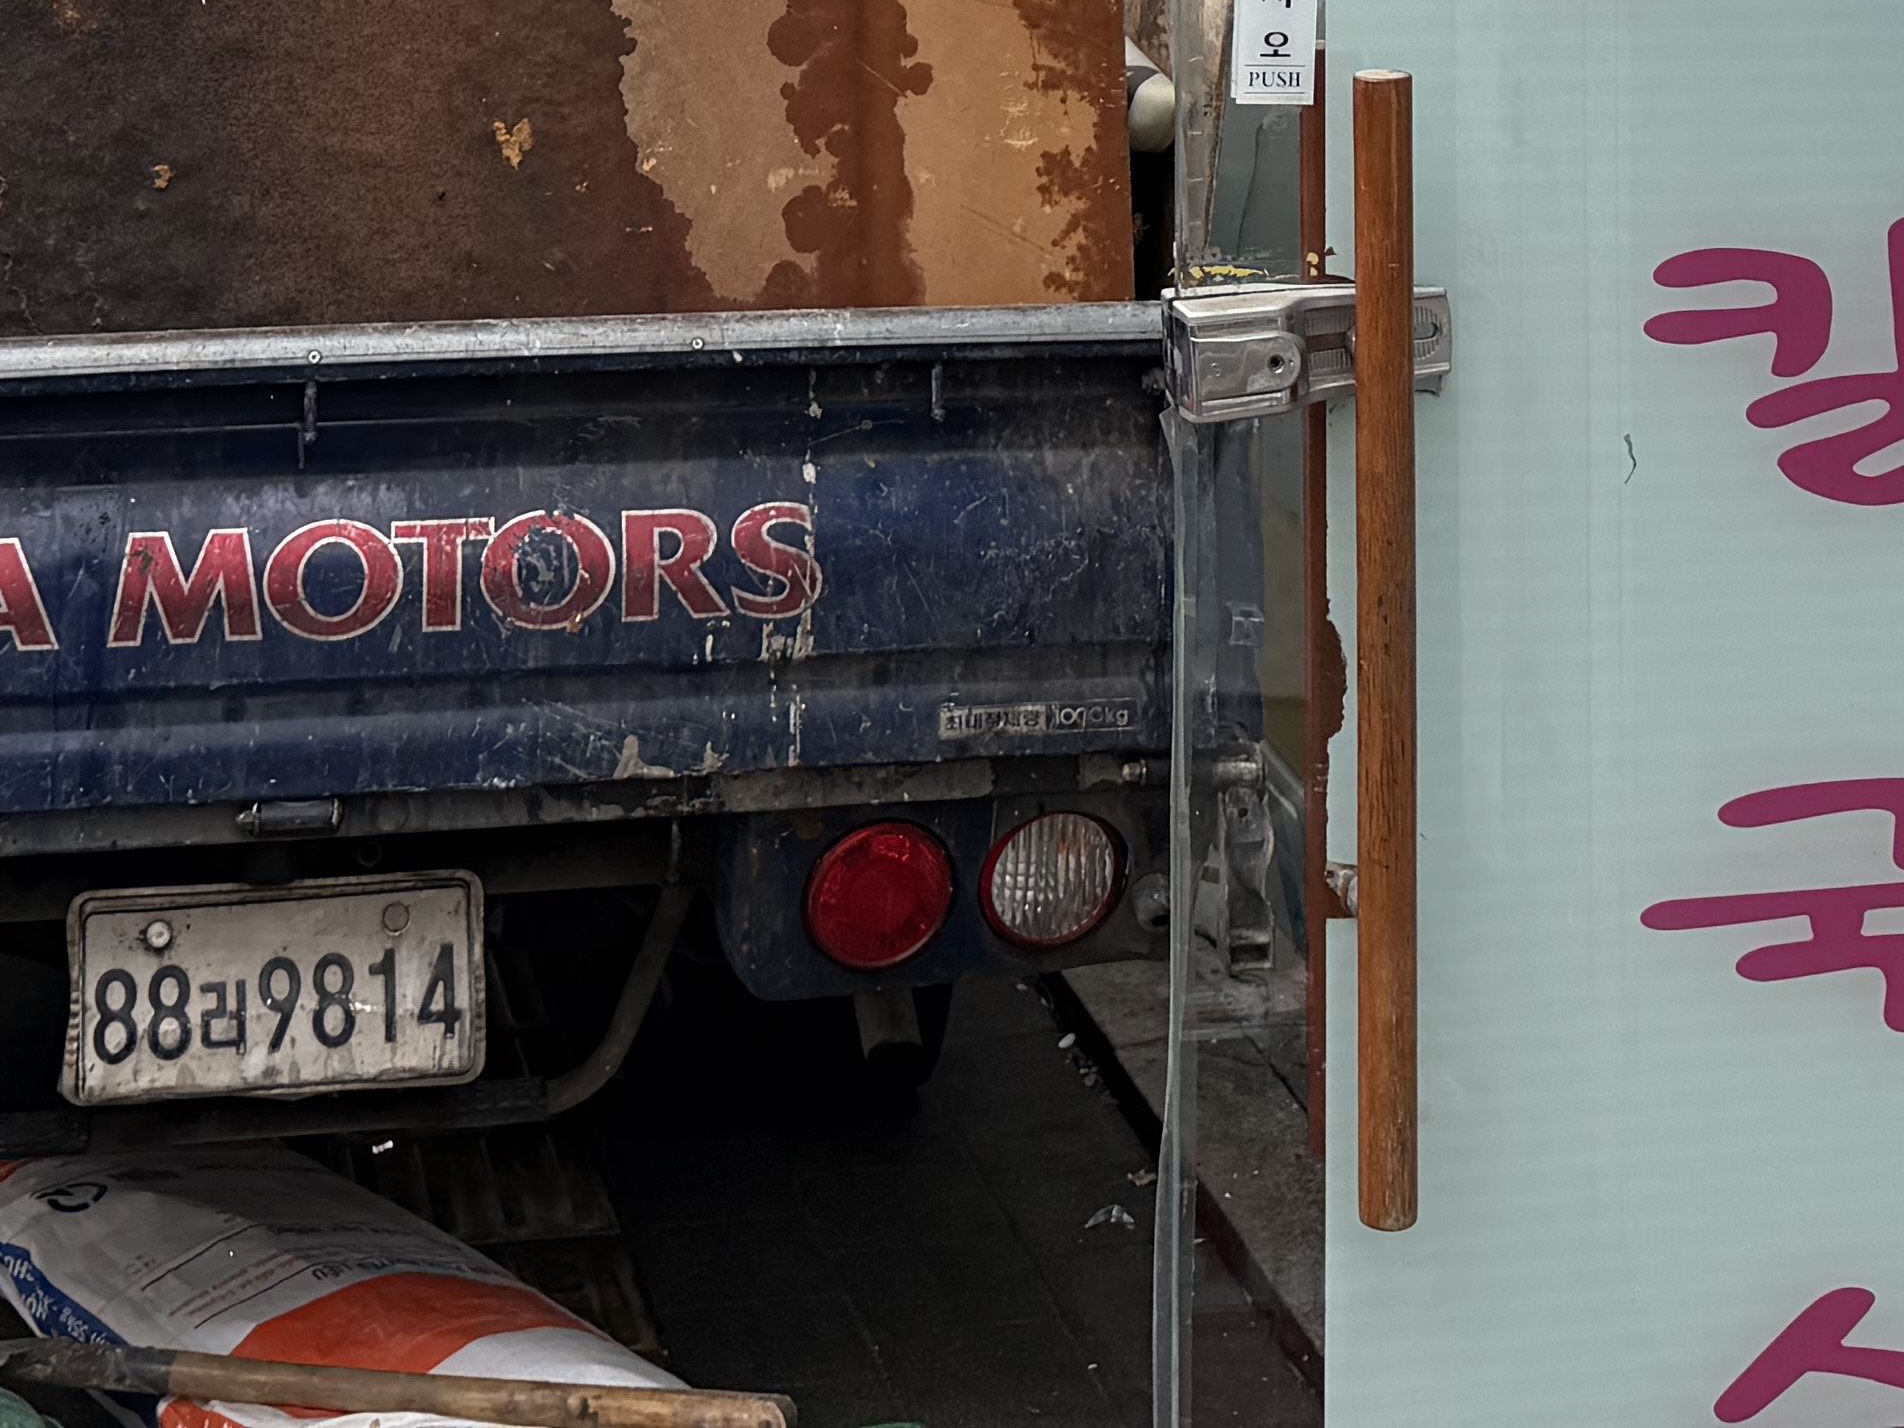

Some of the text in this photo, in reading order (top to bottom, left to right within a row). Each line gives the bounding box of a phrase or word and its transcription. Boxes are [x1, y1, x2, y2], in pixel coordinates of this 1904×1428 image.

[1248, 71, 1302, 89] PUSH
[107, 501, 823, 648] MOTORS
[93, 942, 461, 1069] 88러9814
